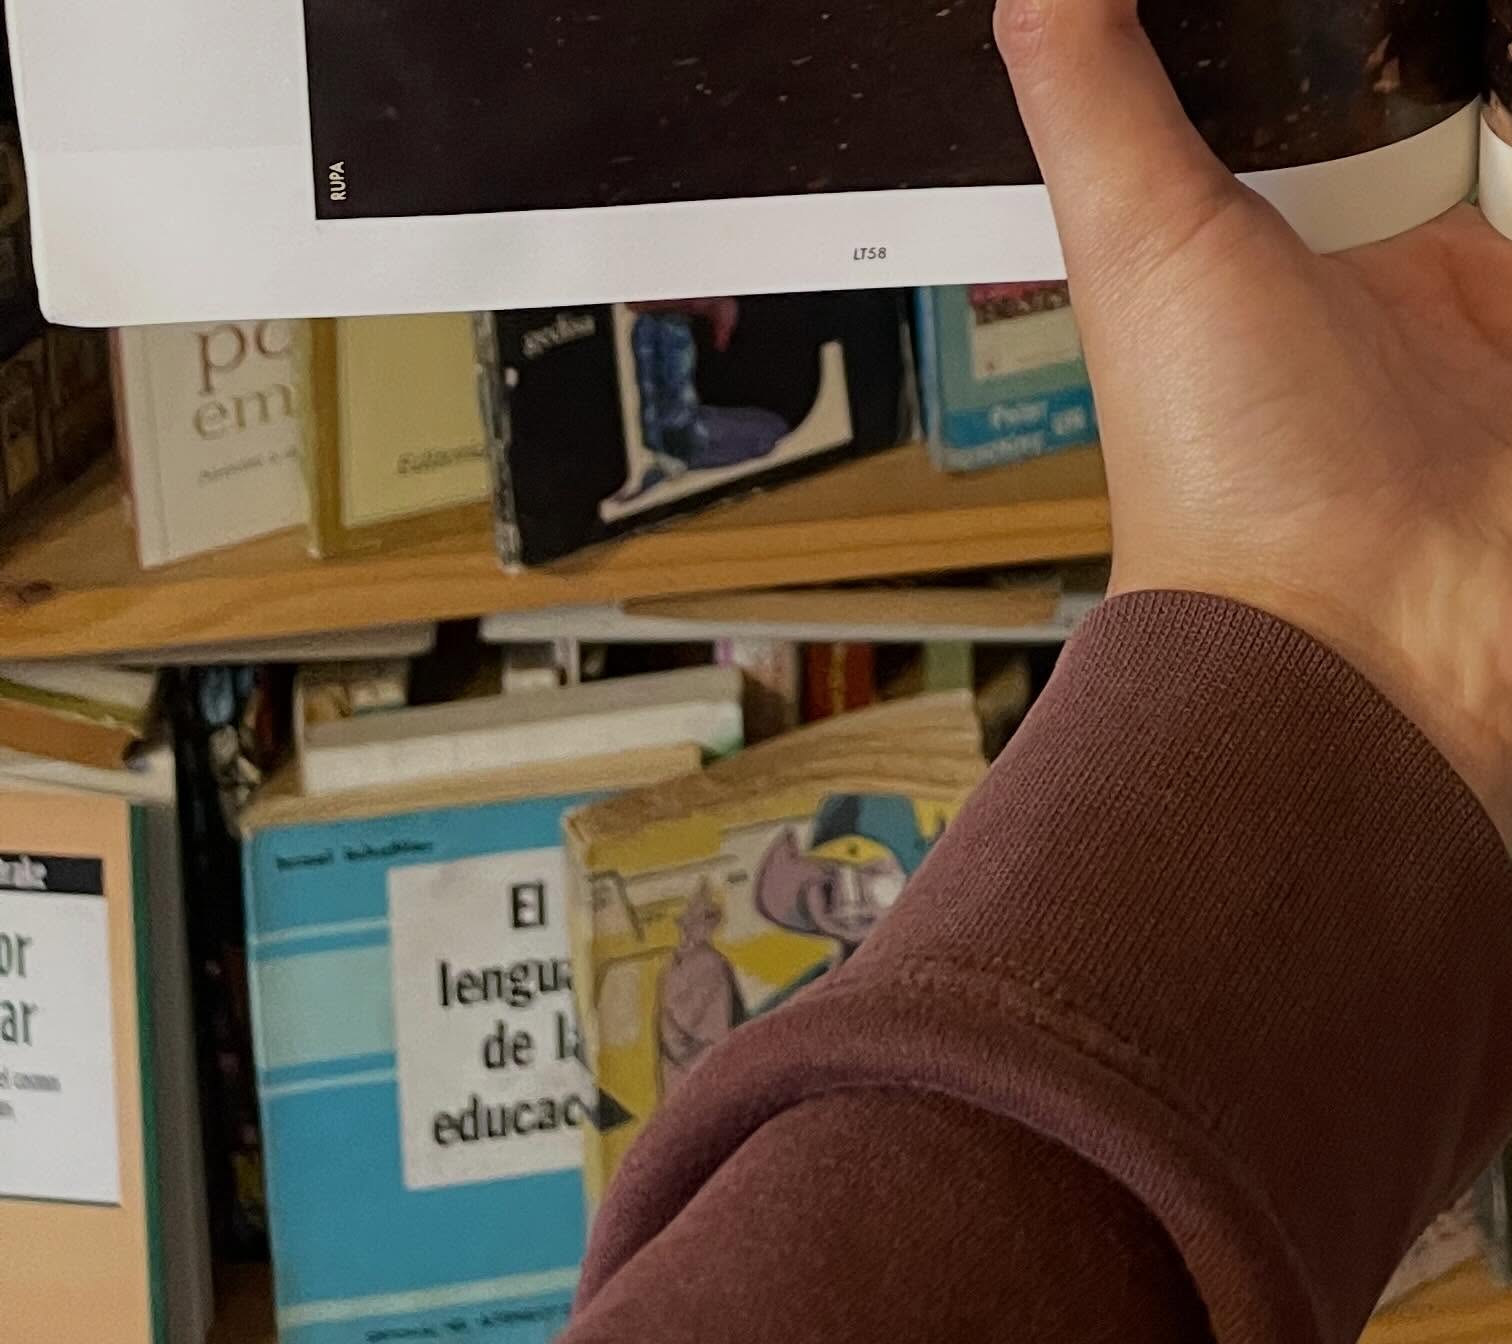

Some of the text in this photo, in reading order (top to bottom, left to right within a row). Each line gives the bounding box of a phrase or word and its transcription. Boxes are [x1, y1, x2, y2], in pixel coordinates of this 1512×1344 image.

[328, 161, 347, 201] RUPA
[853, 246, 888, 262] LT58
[510, 881, 546, 929] El
[482, 1019, 533, 1069] de
